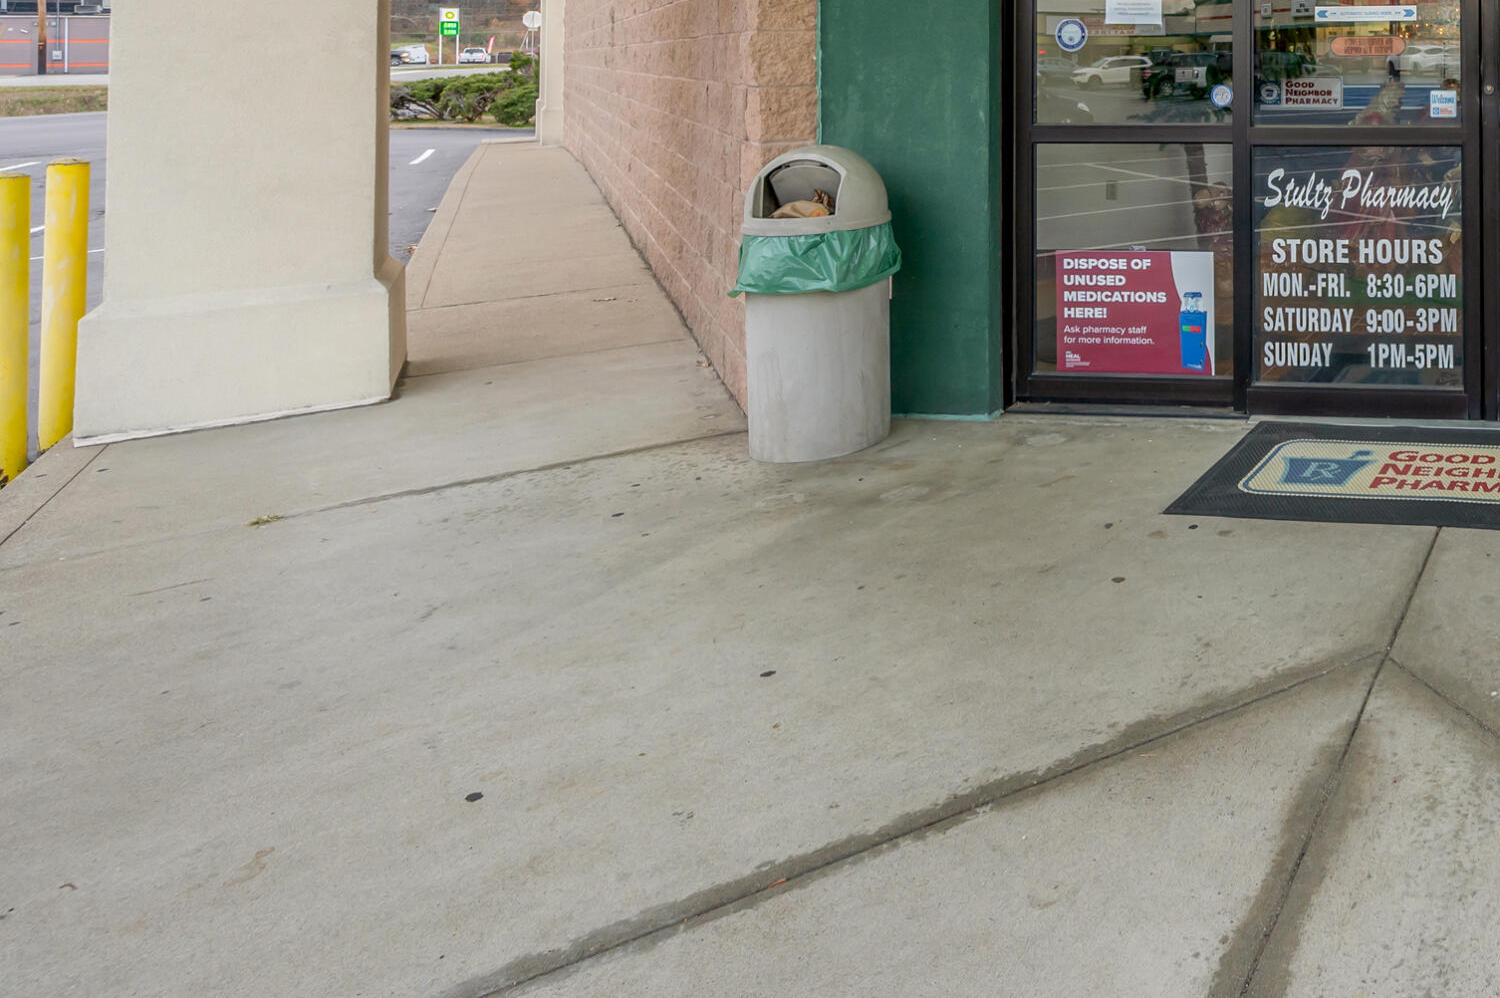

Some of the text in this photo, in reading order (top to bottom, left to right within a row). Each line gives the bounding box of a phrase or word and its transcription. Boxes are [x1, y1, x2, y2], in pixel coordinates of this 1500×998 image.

[1286, 97, 1338, 105] PHARMACY
[1264, 168, 1453, 220] Stultz Pharmacy
[1272, 238, 1443, 264] STORE HOURS
[1063, 258, 1152, 270] DISPOSE OF
[1063, 275, 1126, 286] UNUSED
[1263, 272, 1456, 298] MON.-FRI. 8:30-6PM
[1064, 291, 1167, 302] MEDICATIONS
[1064, 307, 1107, 319] HERE!
[1264, 307, 1457, 333] SATURDAY 9:00-3PM
[1064, 325, 1147, 336] Ask pharmacy staff
[1064, 336, 1076, 344] for
[1104, 337, 1155, 345] information.
[1264, 341, 1454, 369] SUNDAY 1PM-5PM
[1388, 450, 1496, 464] GOOD
